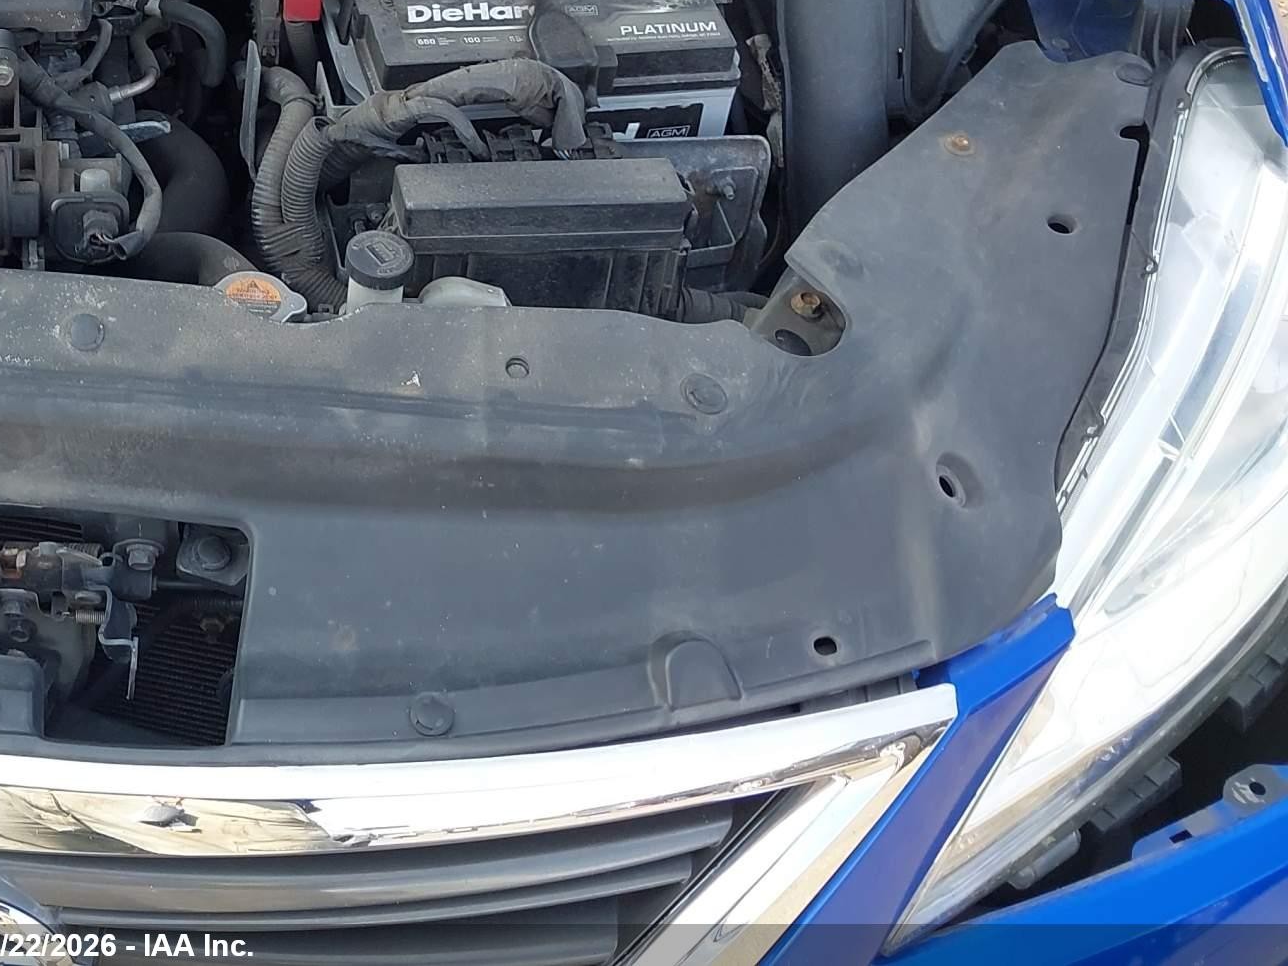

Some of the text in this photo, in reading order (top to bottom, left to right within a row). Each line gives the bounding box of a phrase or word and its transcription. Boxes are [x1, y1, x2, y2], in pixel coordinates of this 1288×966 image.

[407, 2, 536, 23] DieHar
[620, 21, 718, 36] PLATINUM
[650, 128, 687, 138] AGM
